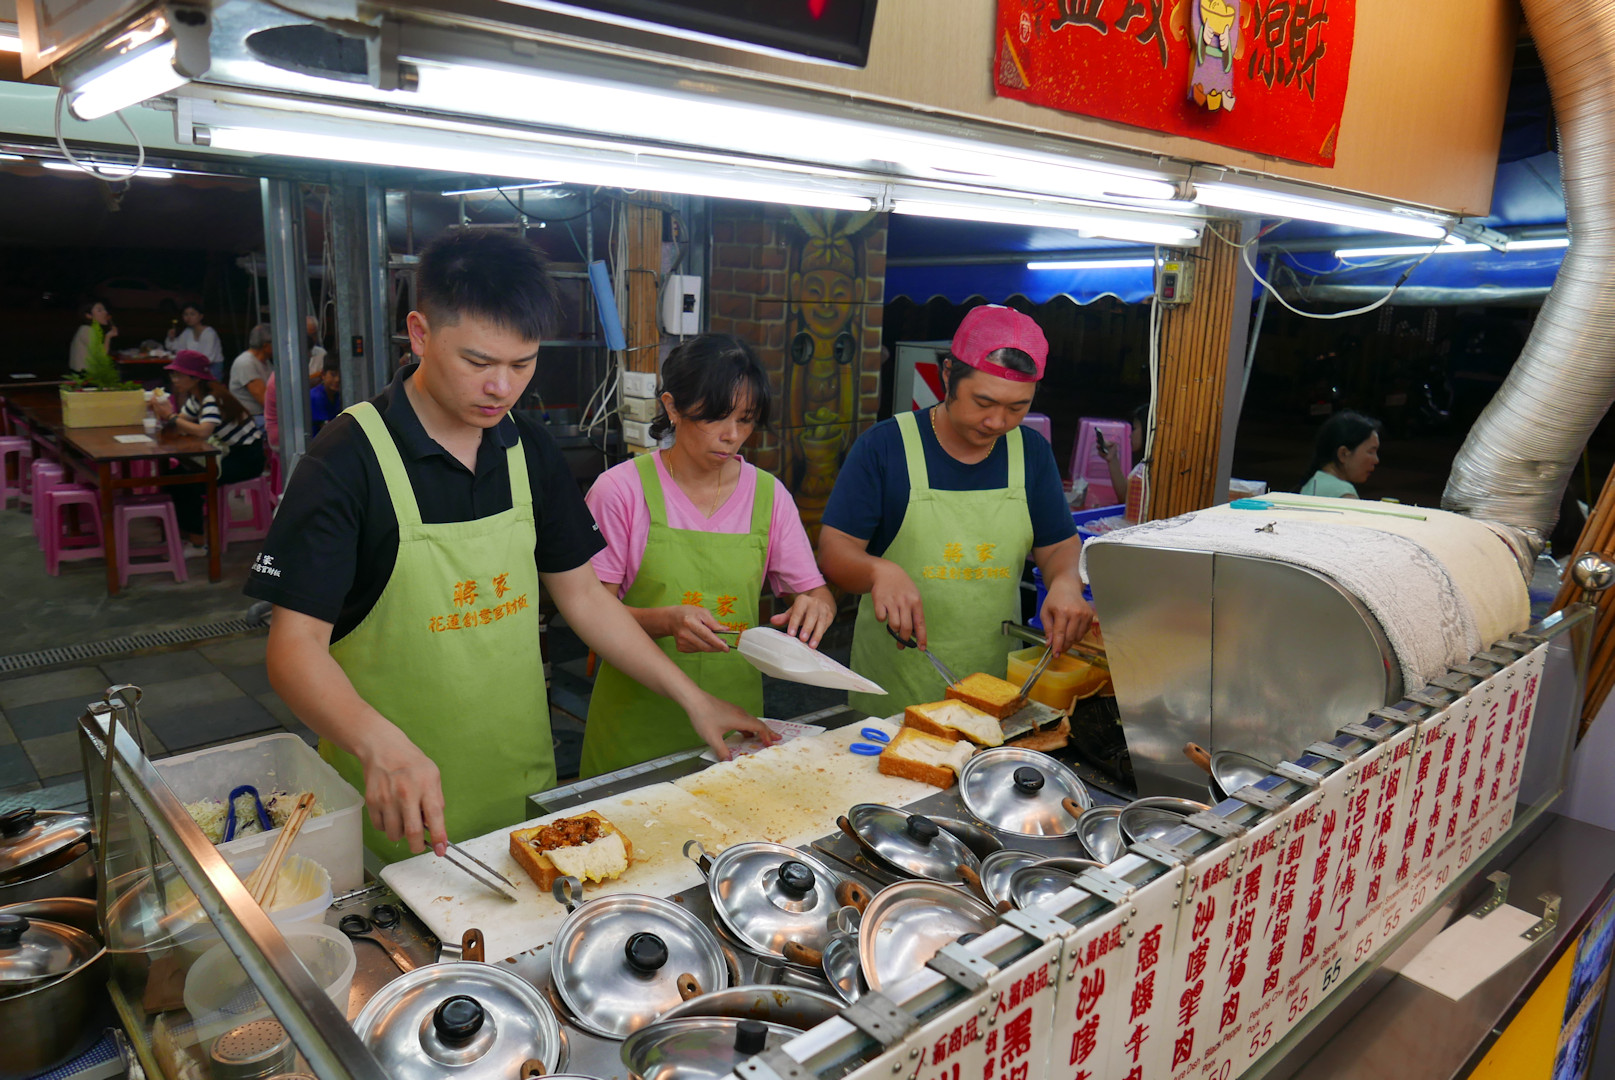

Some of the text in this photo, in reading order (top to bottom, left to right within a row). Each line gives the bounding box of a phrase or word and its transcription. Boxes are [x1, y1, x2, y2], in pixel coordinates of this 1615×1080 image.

[944, 542, 996, 563] 蔣家
[453, 572, 511, 608] 蔣家
[1499, 809, 1511, 832] 50
[1478, 826, 1492, 850] 50
[1334, 788, 1369, 931] 宮保雞丁
[1458, 844, 1472, 869] 50
[1190, 857, 1230, 898] 人氣商品
[1435, 864, 1449, 890] 50
[1410, 886, 1426, 912] 50
[1383, 907, 1401, 937] 55
[1072, 924, 1122, 974] 人氣商品
[1354, 932, 1373, 962] 55
[994, 963, 1049, 1018] 人氣商品
[1171, 895, 1215, 1072] 沙嗲羊肉
[1322, 957, 1342, 991] 55
[1288, 987, 1309, 1022] 55
[1069, 968, 1105, 1080] 沙嗲
[1248, 1021, 1273, 1058] 55
